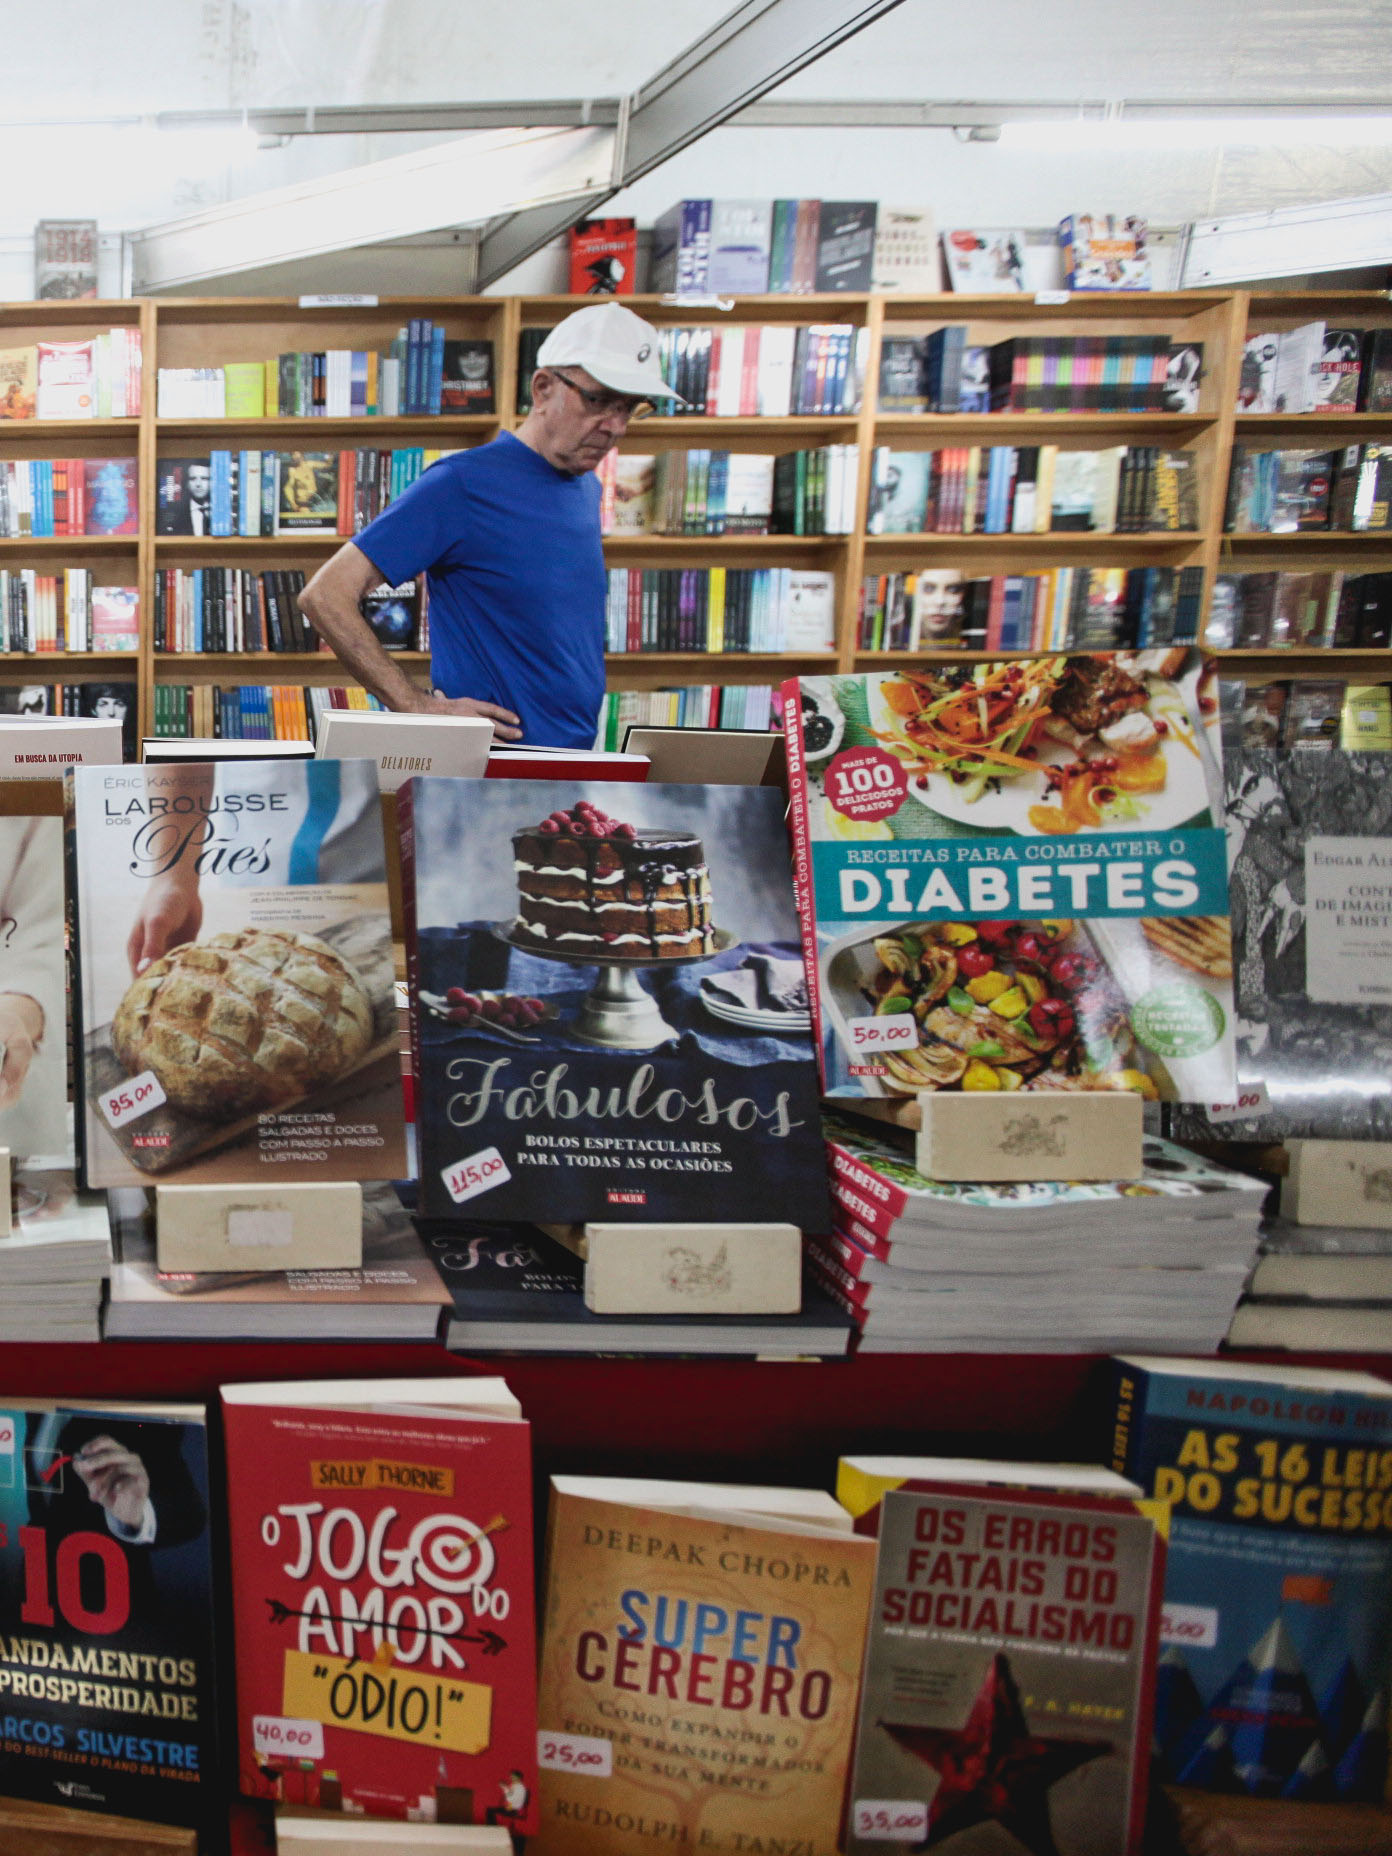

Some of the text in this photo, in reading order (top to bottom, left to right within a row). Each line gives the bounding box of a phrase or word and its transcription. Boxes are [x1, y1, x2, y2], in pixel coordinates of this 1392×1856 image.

[785, 698, 800, 771] DIABETES
[14, 753, 83, 764] EM BUSCA DA UTOPIA
[380, 756, 432, 772] DELATORES
[841, 757, 878, 769] MAIS DE
[835, 764, 895, 795] 100
[105, 793, 289, 816] LAROUSSE
[837, 787, 903, 807] DELICIOSOS
[851, 801, 894, 814] PRATOS
[129, 810, 271, 878] Pães
[847, 840, 1185, 864] RECEITAS PARA COMBATER O
[838, 860, 1200, 914] DIABETES
[108, 1083, 154, 1116] 85,00
[446, 1056, 806, 1137] Fabulosos
[258, 1124, 378, 1137] SALGADAS E DOCES
[278, 1112, 336, 1124] RECEITAS
[259, 1137, 384, 1149] COM PASSO A PASSO
[260, 1150, 328, 1162] ILUSTRADO
[526, 1134, 722, 1154] BOLOS ESPETACULARES
[451, 1156, 504, 1195] 115,00
[517, 1152, 733, 1173] PARA TODAS AS OCASIÕES
[834, 1155, 891, 1201] DIABETES
[1177, 1430, 1240, 1473] AS
[1254, 1440, 1310, 1483] 16
[319, 1462, 446, 1491] SALLY THORNE
[1154, 1466, 1221, 1512] DO
[261, 1501, 497, 1594] O JOGO
[914, 1506, 967, 1546] OS
[984, 1513, 1118, 1562] ERROS
[582, 1524, 854, 1589] DEEPAK CHOPRA
[18, 1526, 131, 1636] 10
[906, 1548, 1118, 1605] FATAIS DO
[298, 1583, 510, 1669] AMOR DO
[616, 1588, 803, 1670] SUPER
[882, 1588, 1135, 1652] SOCIALISMO
[575, 1627, 833, 1721] CÉREBRO
[77, 1729, 200, 1770] SILVESTRE
[255, 1723, 313, 1746] 40,00
[543, 1742, 604, 1769] 25,00
[858, 1811, 925, 1833] 35,00
